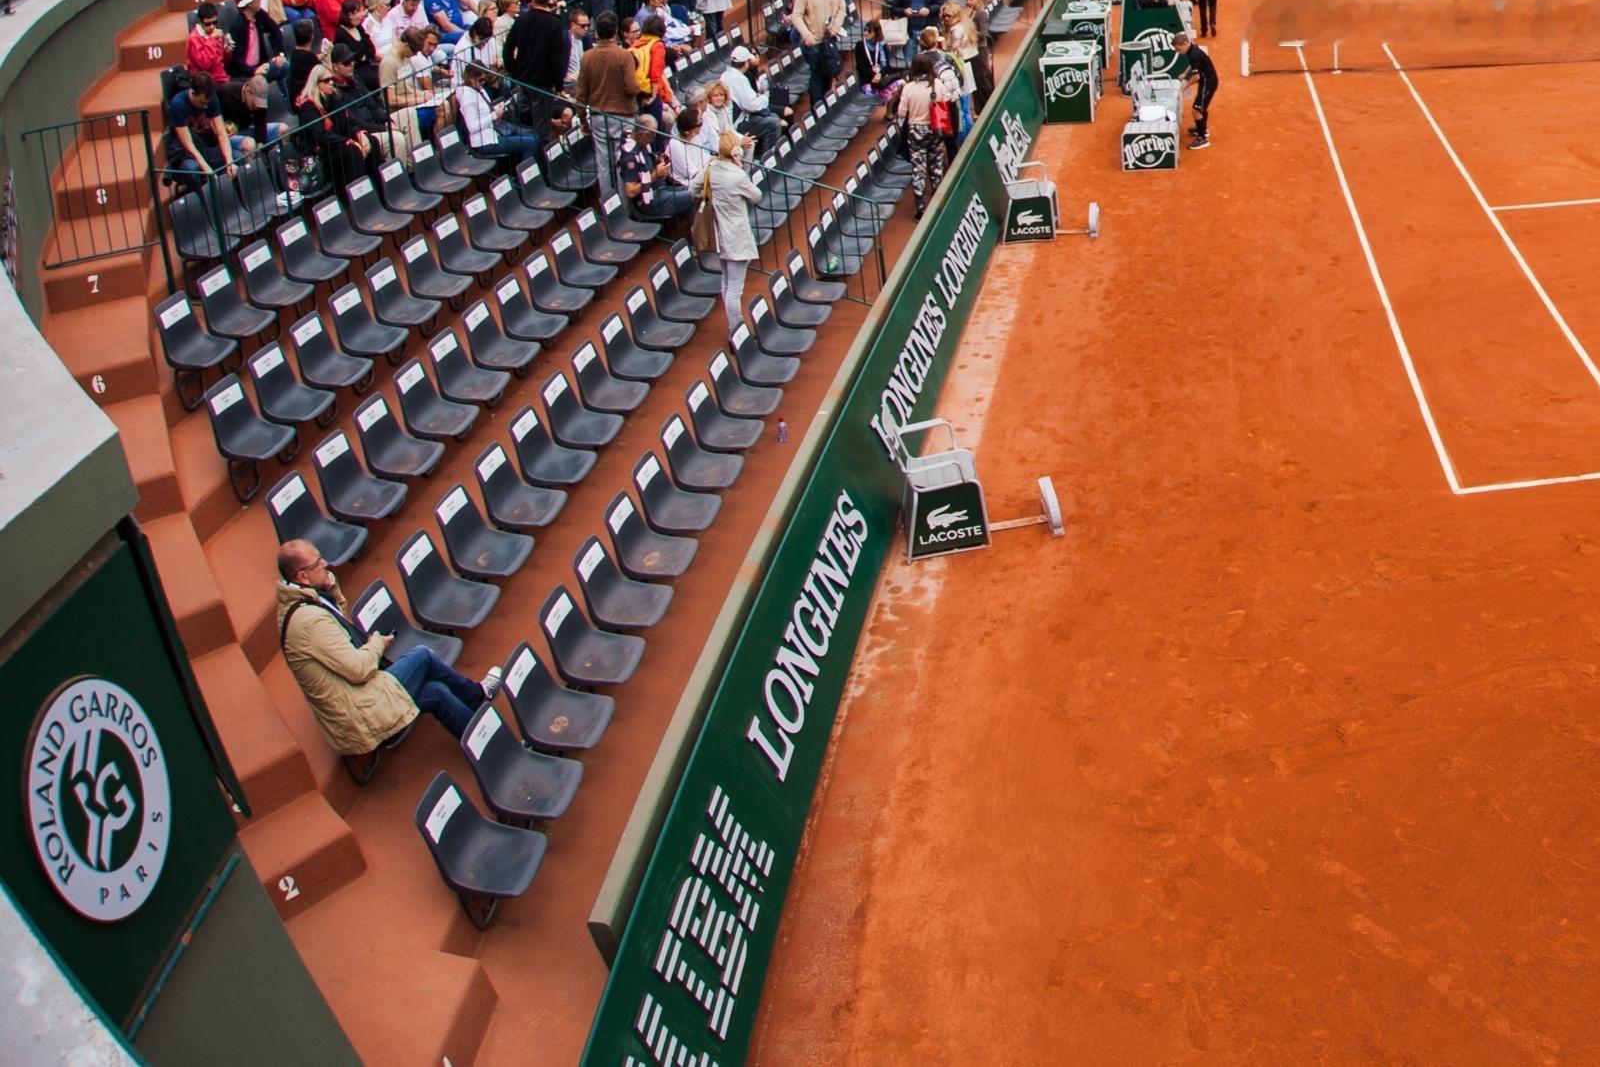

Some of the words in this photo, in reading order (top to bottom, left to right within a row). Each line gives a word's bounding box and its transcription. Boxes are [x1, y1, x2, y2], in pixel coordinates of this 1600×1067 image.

[146, 46, 162, 60] 10
[116, 114, 126, 128] 9
[95, 188, 108, 206] 8
[1010, 226, 1052, 236] LACOSTE
[933, 191, 990, 312] LONGINES
[87, 274, 100, 295] 7
[91, 374, 107, 395] 6
[870, 290, 948, 460] LONGINES
[918, 524, 984, 546] LACOSTE
[746, 489, 869, 783] LONGINES
[36, 719, 76, 886] ROLAND
[68, 690, 159, 769] GARROS
[99, 809, 164, 906] PARIS
[278, 875, 301, 901] 2
[653, 784, 776, 1041] IBM
